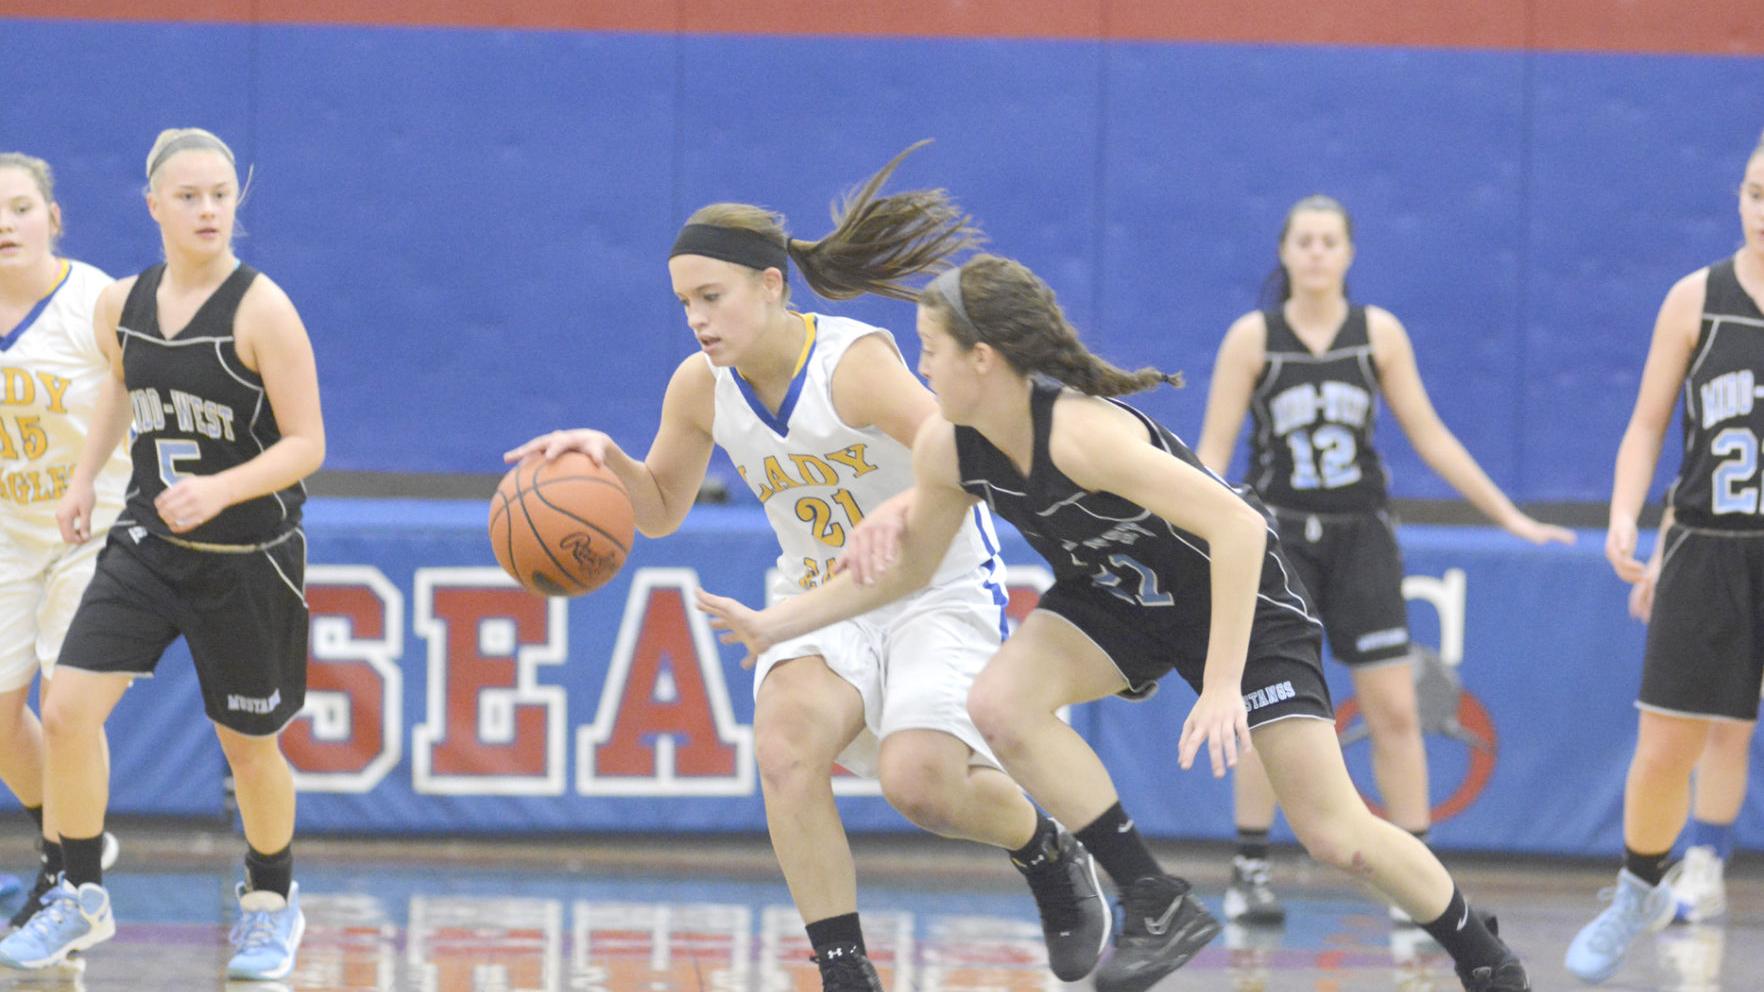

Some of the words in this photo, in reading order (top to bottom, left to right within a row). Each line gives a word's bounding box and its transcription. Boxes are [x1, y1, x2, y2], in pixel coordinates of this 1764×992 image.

[0, 415, 48, 460] 15
[155, 438, 202, 490] 5
[1286, 422, 1362, 490] 12
[0, 463, 76, 506] GLE
[738, 443, 879, 504] LADY
[1711, 427, 1764, 515] 2
[795, 488, 865, 548] 21
[1243, 681, 1296, 712] STANGS
